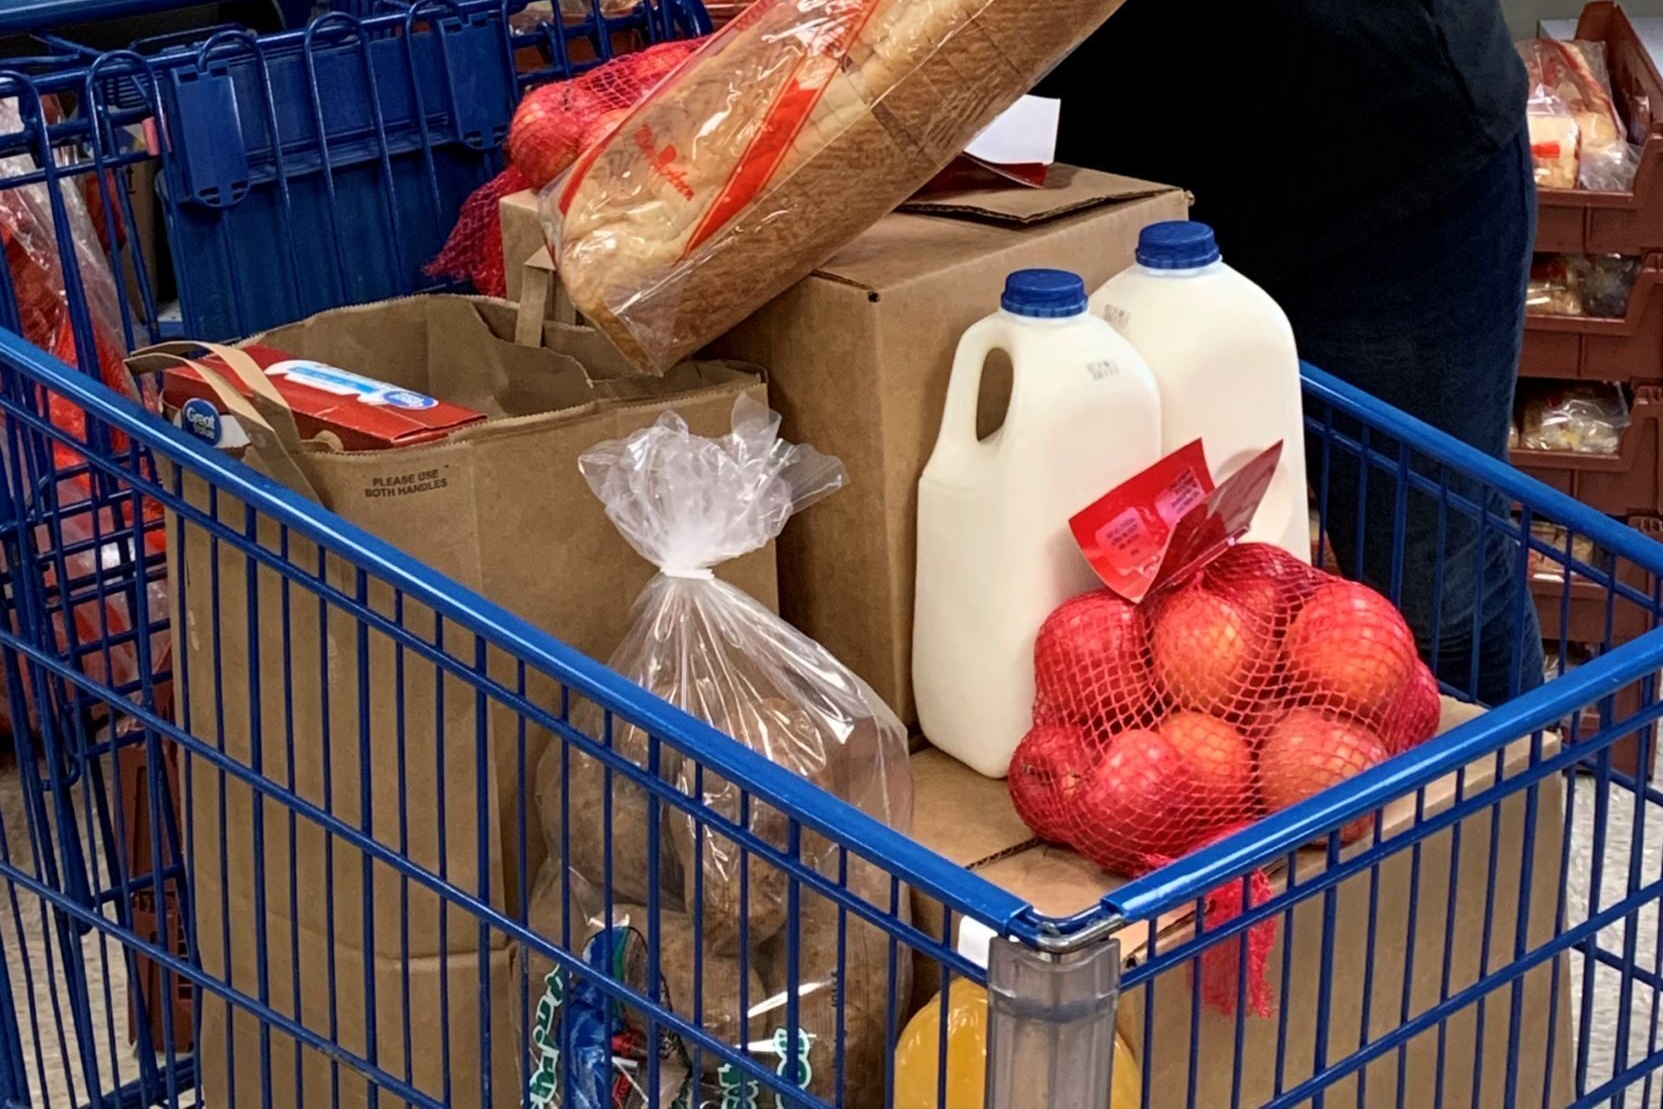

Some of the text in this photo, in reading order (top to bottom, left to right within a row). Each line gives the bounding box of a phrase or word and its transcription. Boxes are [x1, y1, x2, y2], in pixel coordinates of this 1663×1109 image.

[187, 407, 215, 430] Great
[373, 469, 438, 486] PLEASE USE
[365, 478, 448, 497] BOTH HANDLES
